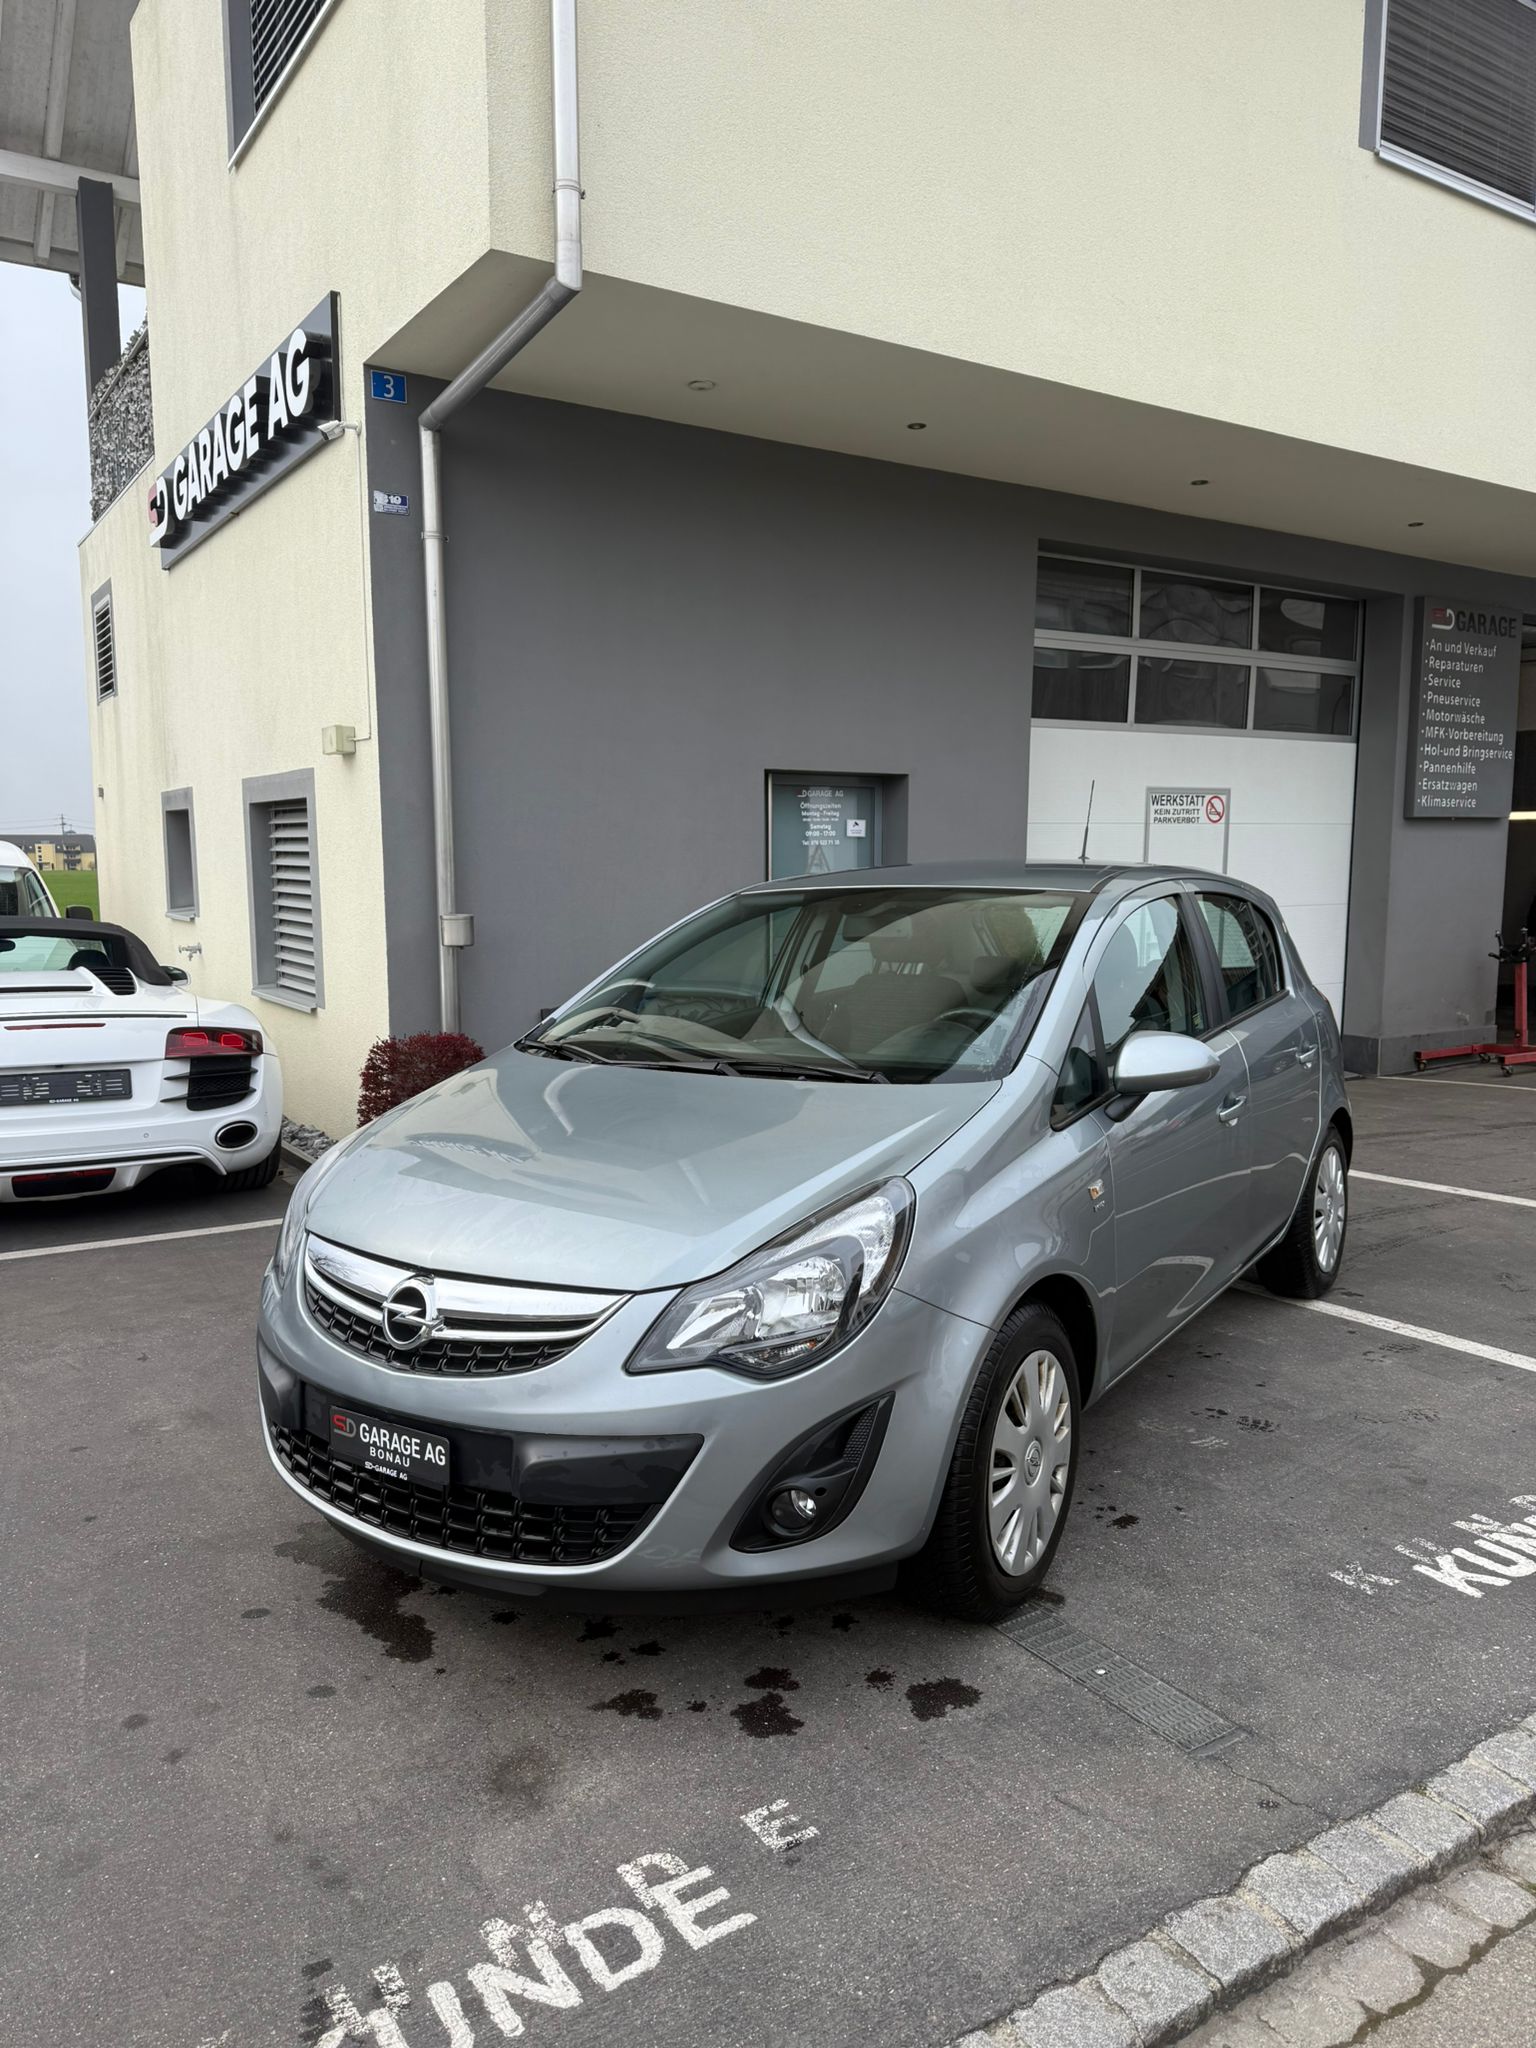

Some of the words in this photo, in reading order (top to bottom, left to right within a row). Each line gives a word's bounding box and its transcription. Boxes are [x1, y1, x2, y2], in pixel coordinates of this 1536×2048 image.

[383, 375, 395, 398] 3
[173, 375, 260, 521] GARAGE
[268, 328, 310, 440] AG
[1456, 609, 1518, 639] GARAGE
[1429, 638, 1443, 652] An
[1444, 640, 1462, 654] und
[1464, 641, 1498, 657] Verkauf
[1428, 655, 1484, 673] Reparaturen
[1428, 673, 1462, 689] Service
[1427, 690, 1481, 707] Pneuservice
[1425, 708, 1486, 725] Motorwäsche
[1424, 725, 1504, 745] MFK-Vorbereitung
[1462, 744, 1513, 761] Bringservice
[1423, 761, 1476, 776] Pannenhilfe
[1422, 778, 1478, 794] Ersatzwagen
[1151, 794, 1206, 807] WERKSTATT
[1421, 794, 1477, 809] Klimaservice
[1153, 808, 1171, 816] KEIN
[1172, 808, 1201, 816] ZUTRITT
[1153, 816, 1201, 824] PARKVERBOT
[333, 1414, 357, 1438] SD
[359, 1423, 421, 1459] GARAGE
[424, 1442, 446, 1466] AG
[369, 1446, 411, 1468] BONAU
[399, 1471, 408, 1481] AG
